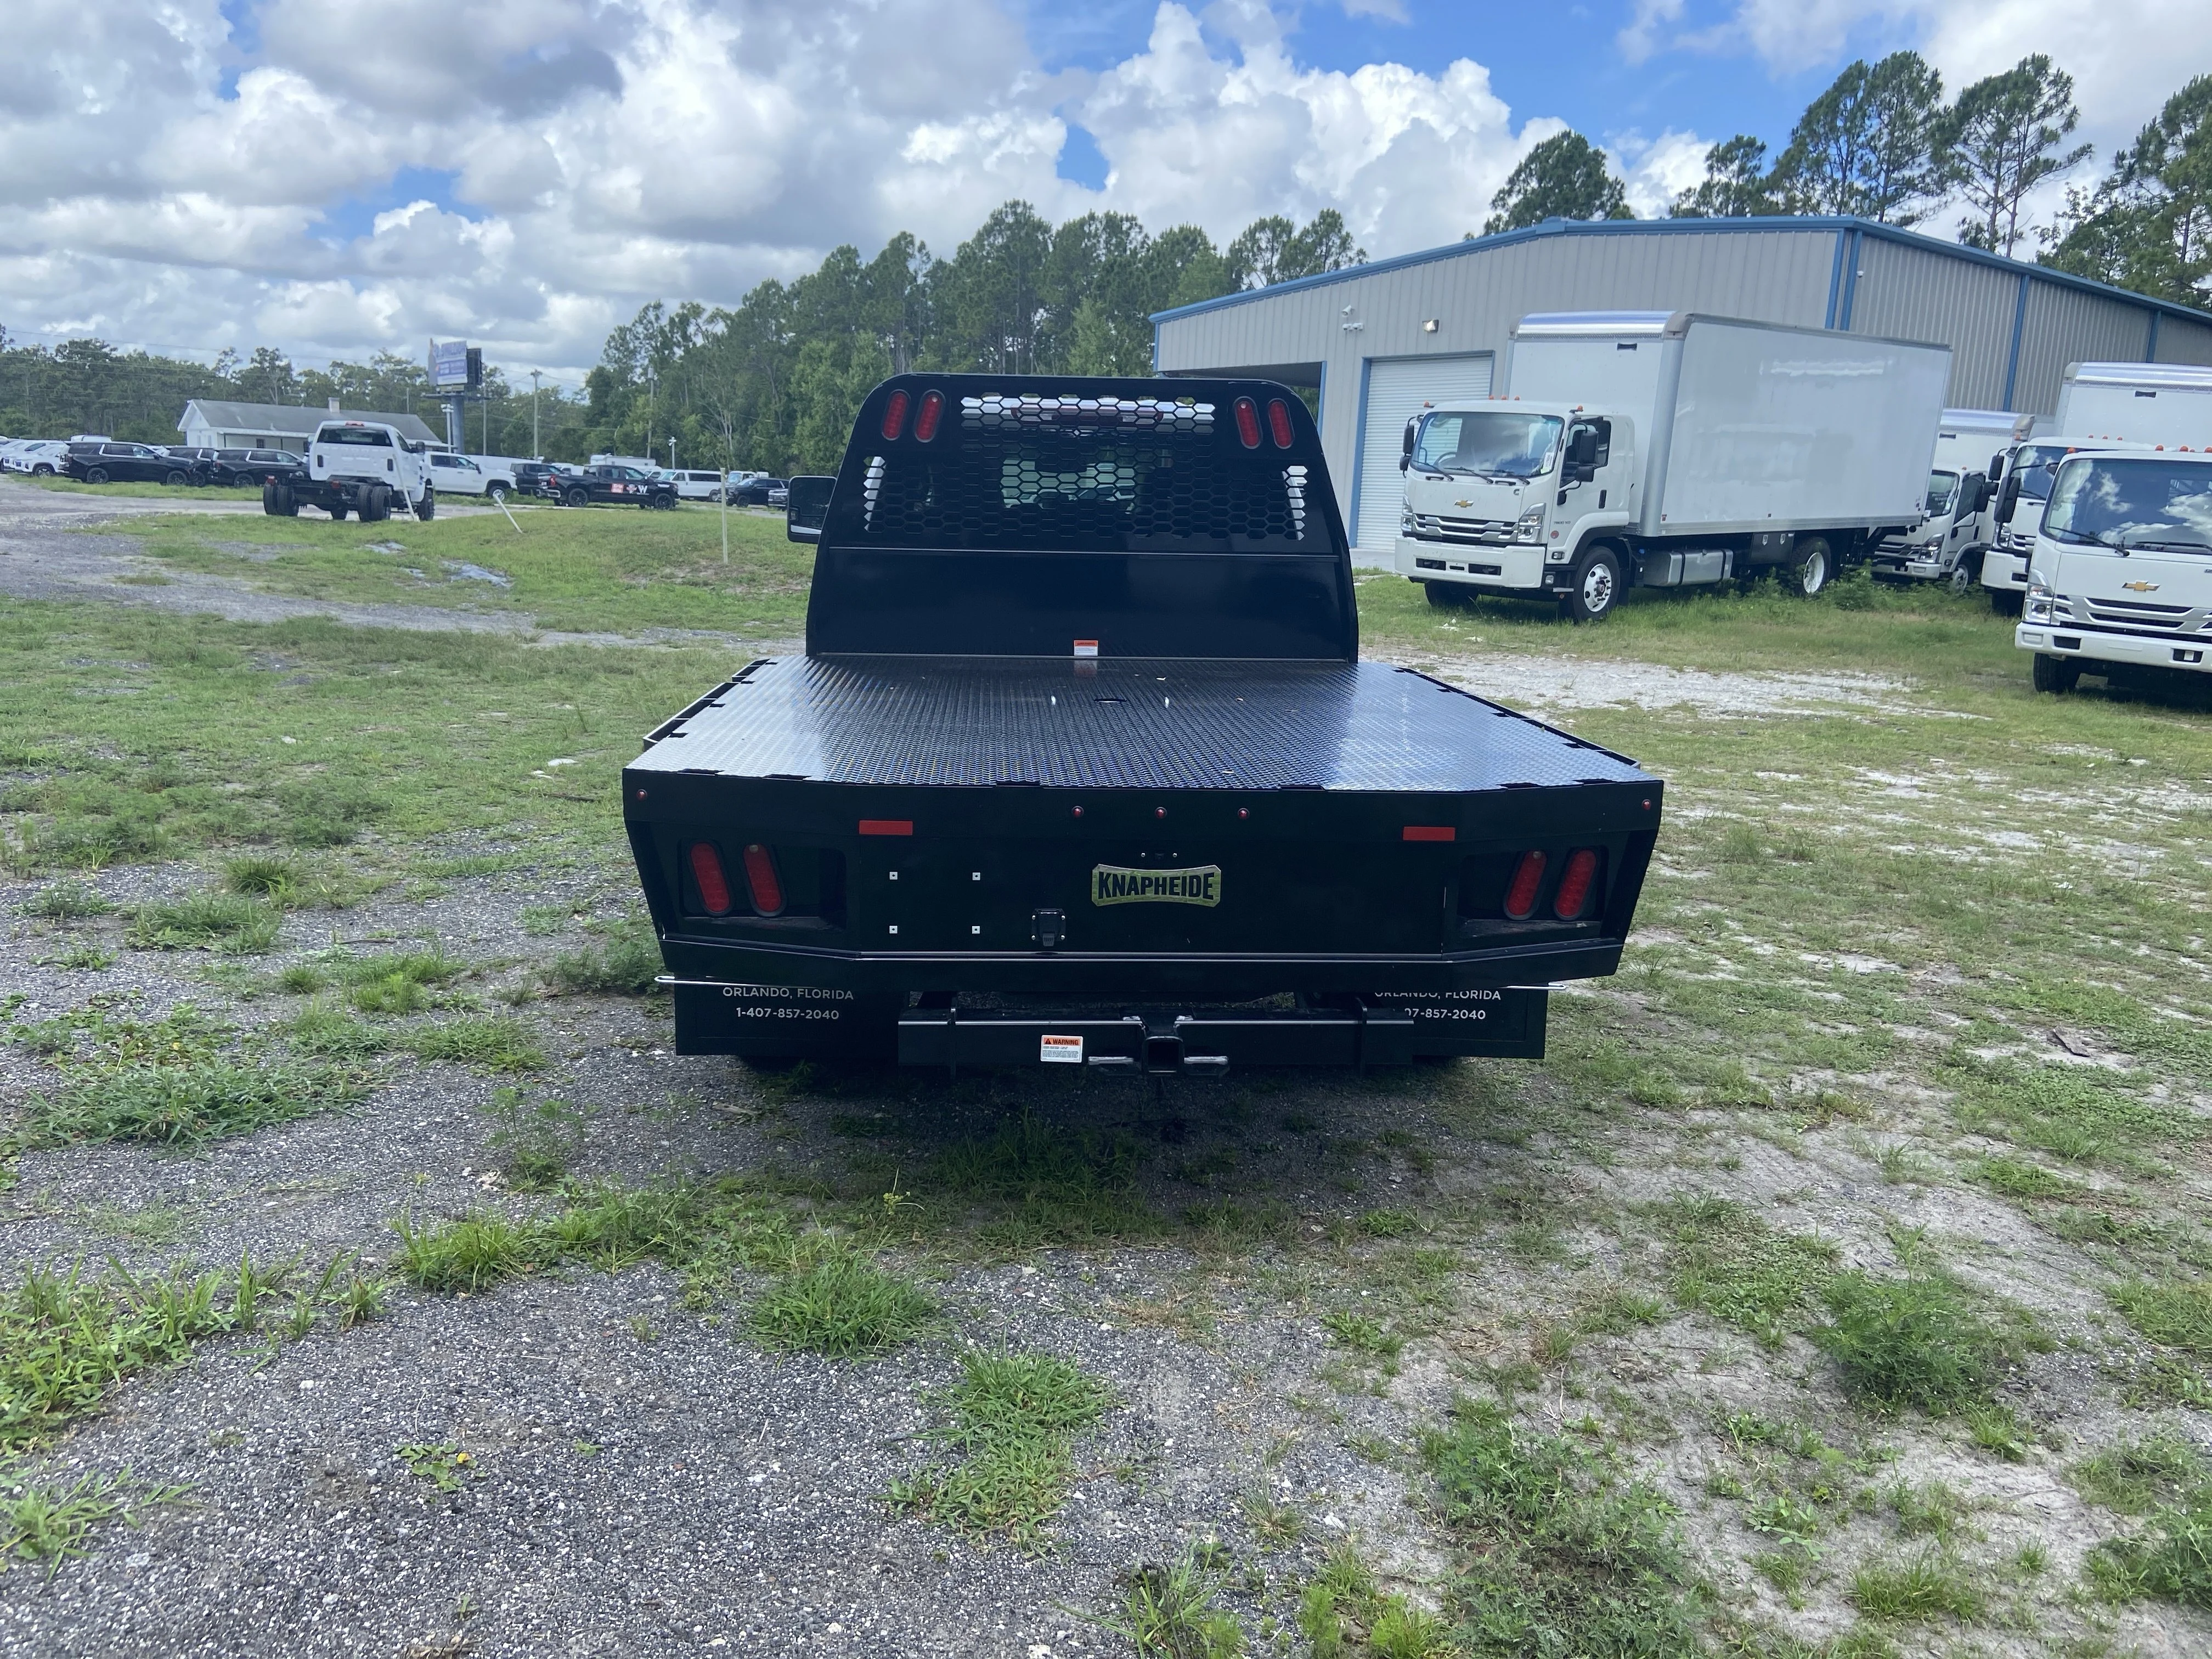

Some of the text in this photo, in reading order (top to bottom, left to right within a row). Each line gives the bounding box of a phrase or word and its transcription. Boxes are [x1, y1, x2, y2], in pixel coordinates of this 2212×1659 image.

[1098, 871, 1215, 900] KNAPHEIDE
[723, 987, 854, 1000] ORLANDO, FLORIDA
[736, 1007, 839, 1019] 1-407-857-2040
